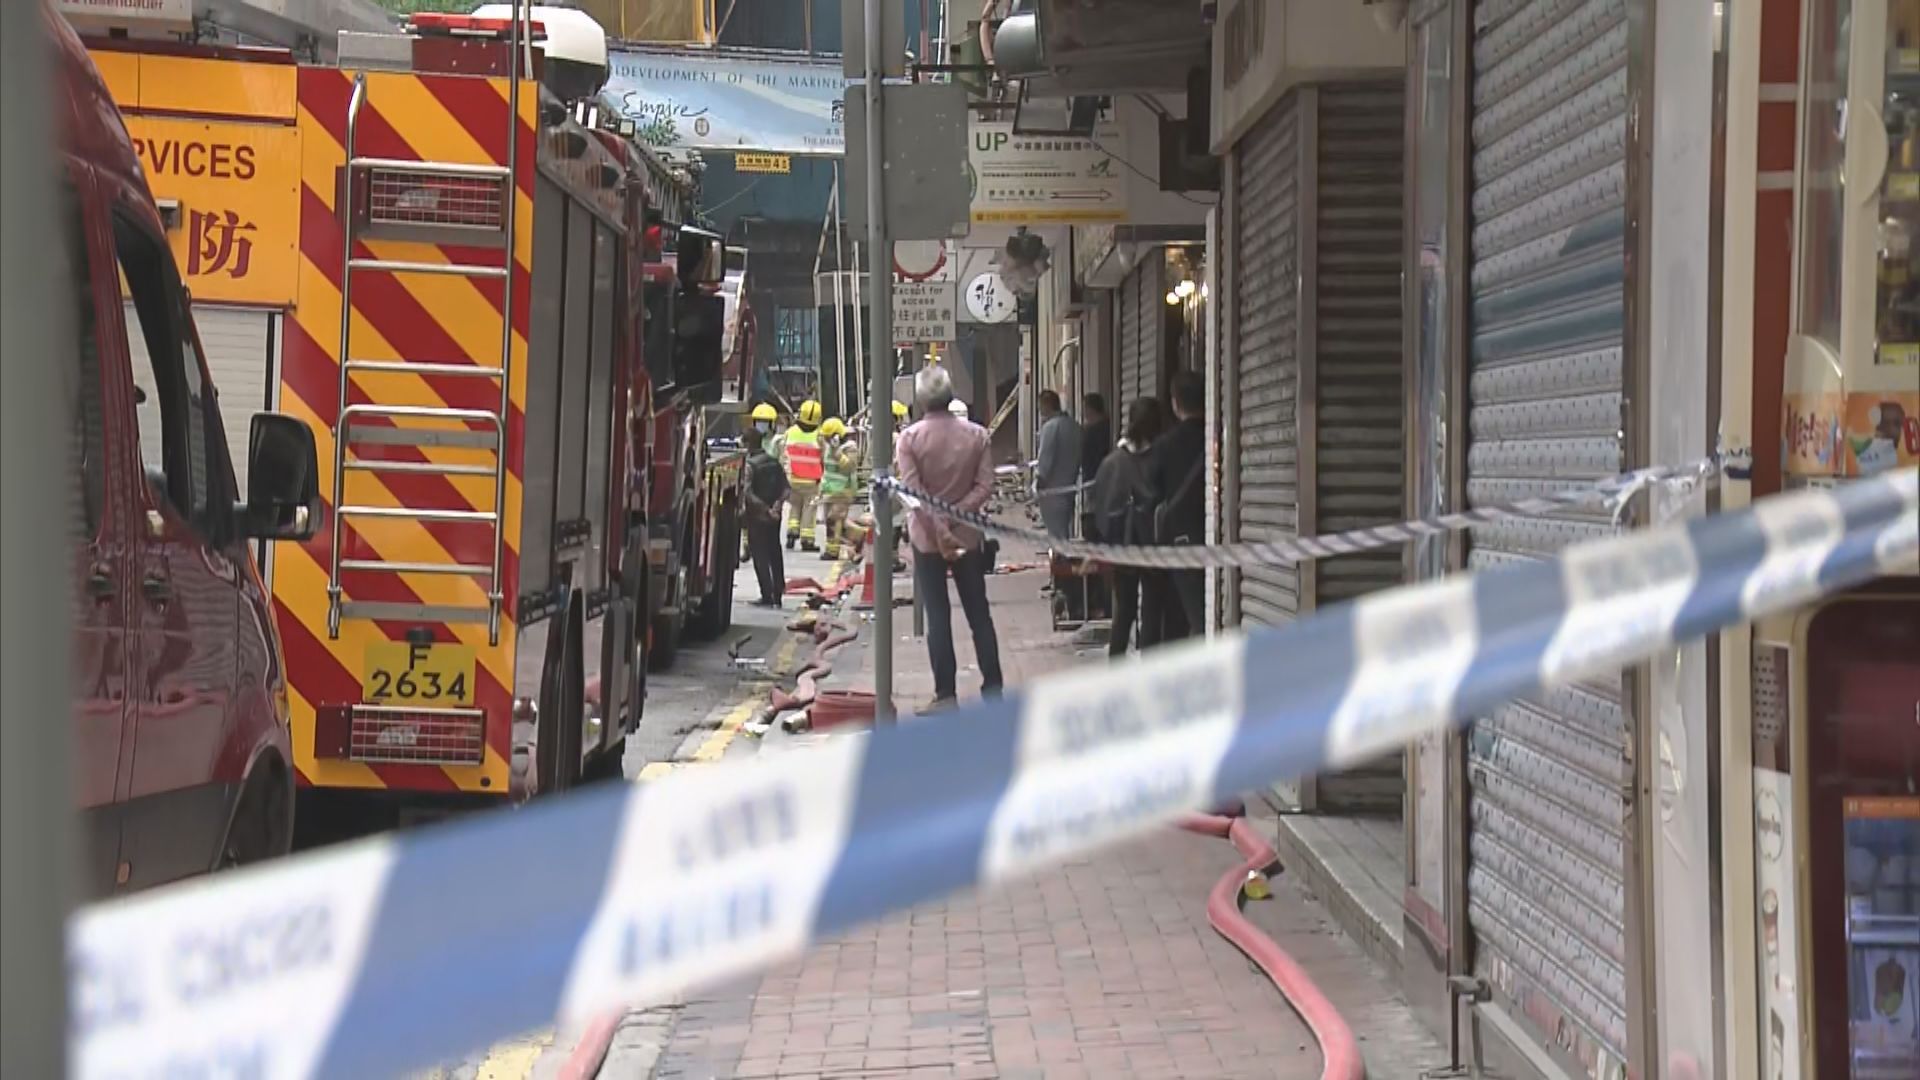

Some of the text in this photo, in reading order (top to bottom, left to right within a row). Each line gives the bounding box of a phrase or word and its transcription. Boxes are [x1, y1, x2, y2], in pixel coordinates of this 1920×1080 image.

[611, 65, 716, 83] EDEVELOPMENT
[622, 90, 708, 125] Empire
[976, 131, 1009, 151] UP
[187, 207, 258, 279] 防
[901, 298, 936, 306] access
[929, 286, 944, 295] for
[409, 643, 433, 671] F
[371, 669, 466, 701] 2634
